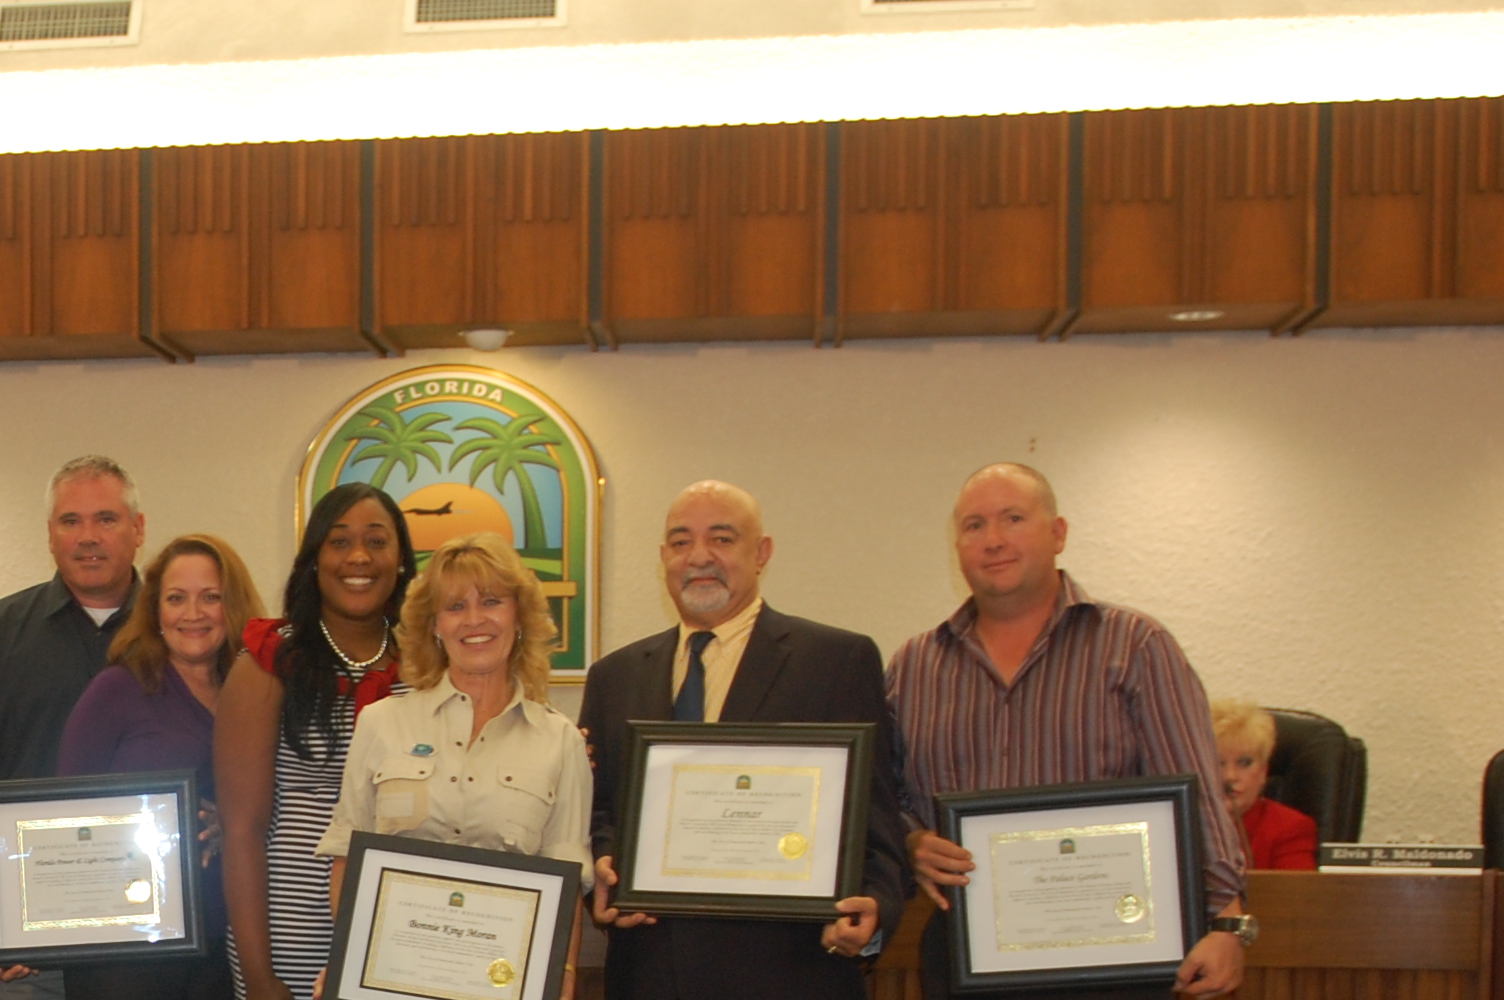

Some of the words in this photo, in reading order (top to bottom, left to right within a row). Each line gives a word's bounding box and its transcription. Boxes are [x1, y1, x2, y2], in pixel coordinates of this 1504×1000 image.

[394, 380, 503, 404] FLORIDA
[1332, 848, 1369, 860] Elvis
[1392, 848, 1474, 861] Maldonado
[409, 919, 440, 932] Bonnie
[442, 924, 464, 938] King
